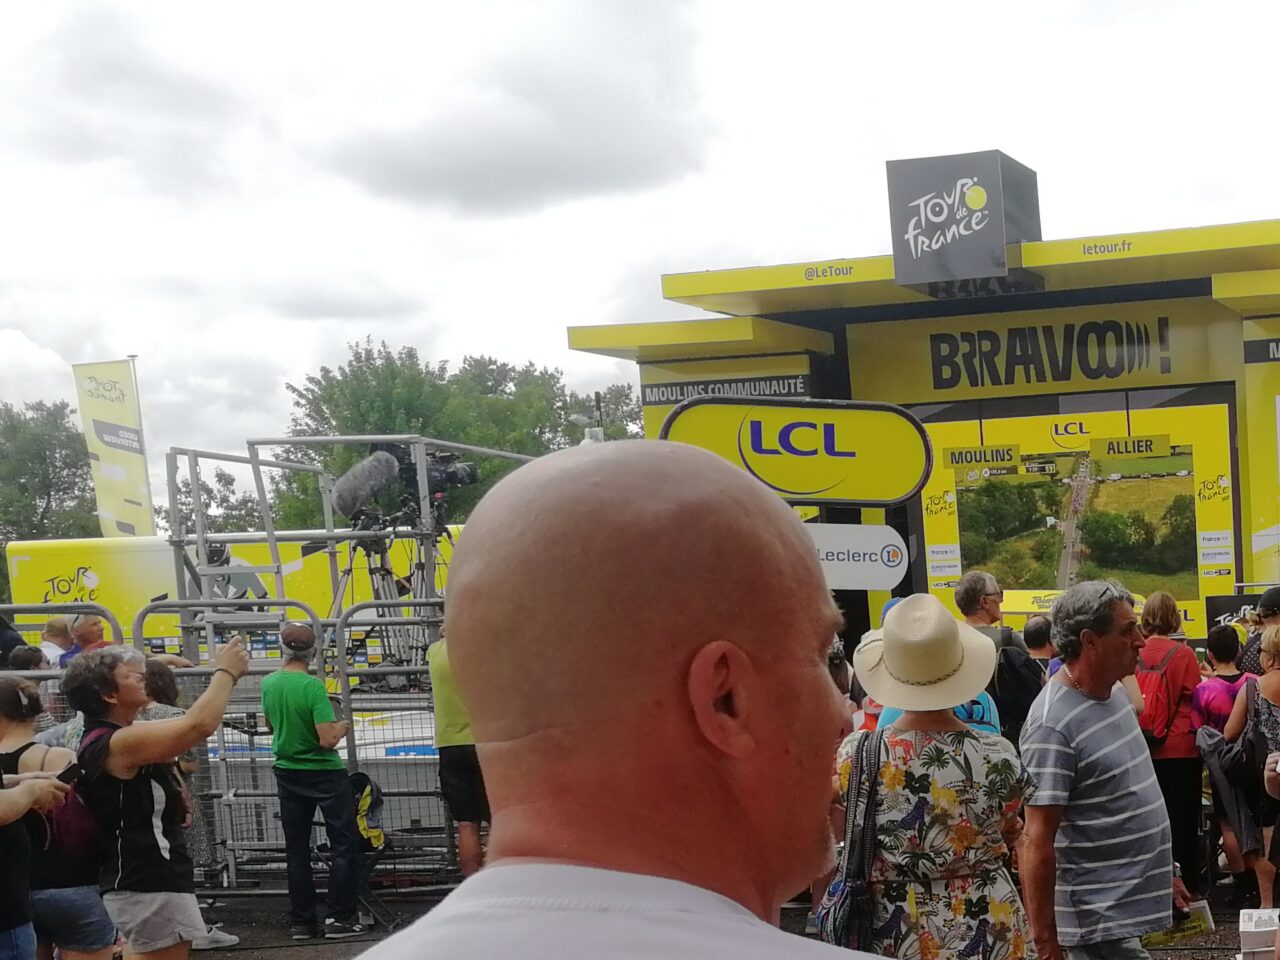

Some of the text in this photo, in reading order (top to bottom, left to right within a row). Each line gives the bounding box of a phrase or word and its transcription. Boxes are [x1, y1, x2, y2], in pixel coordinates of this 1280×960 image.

[1082, 240, 1132, 255] letour.fr
[804, 266, 853, 280] @LeTour
[645, 376, 805, 402] MOULINS COMMUNAUTÉ
[1054, 422, 1090, 435] LCL
[750, 420, 856, 457] LCL
[1107, 439, 1153, 455] ALLIER
[950, 448, 1013, 464] MOULINS
